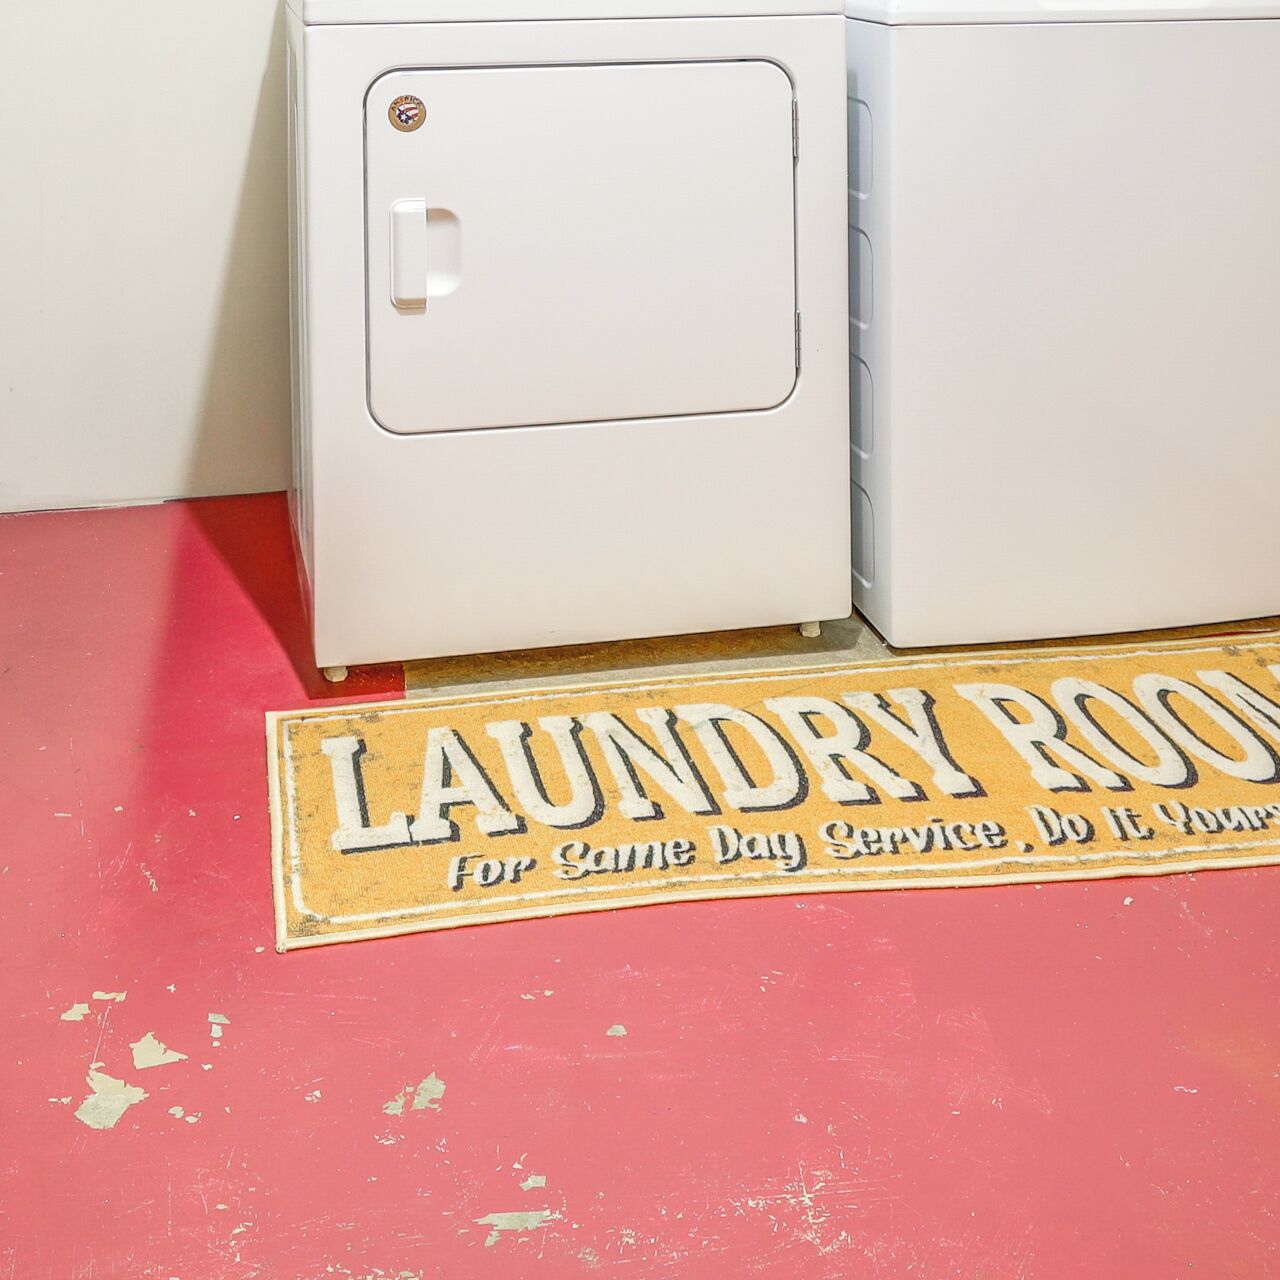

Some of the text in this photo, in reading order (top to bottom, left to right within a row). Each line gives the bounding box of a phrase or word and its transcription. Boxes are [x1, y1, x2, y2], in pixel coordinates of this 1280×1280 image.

[321, 686, 988, 855] LAUNDRY
[448, 852, 537, 893] For
[551, 833, 697, 880] Same
[708, 825, 808, 874] Day
[1028, 803, 1097, 846] Do
[1103, 806, 1156, 842] It
